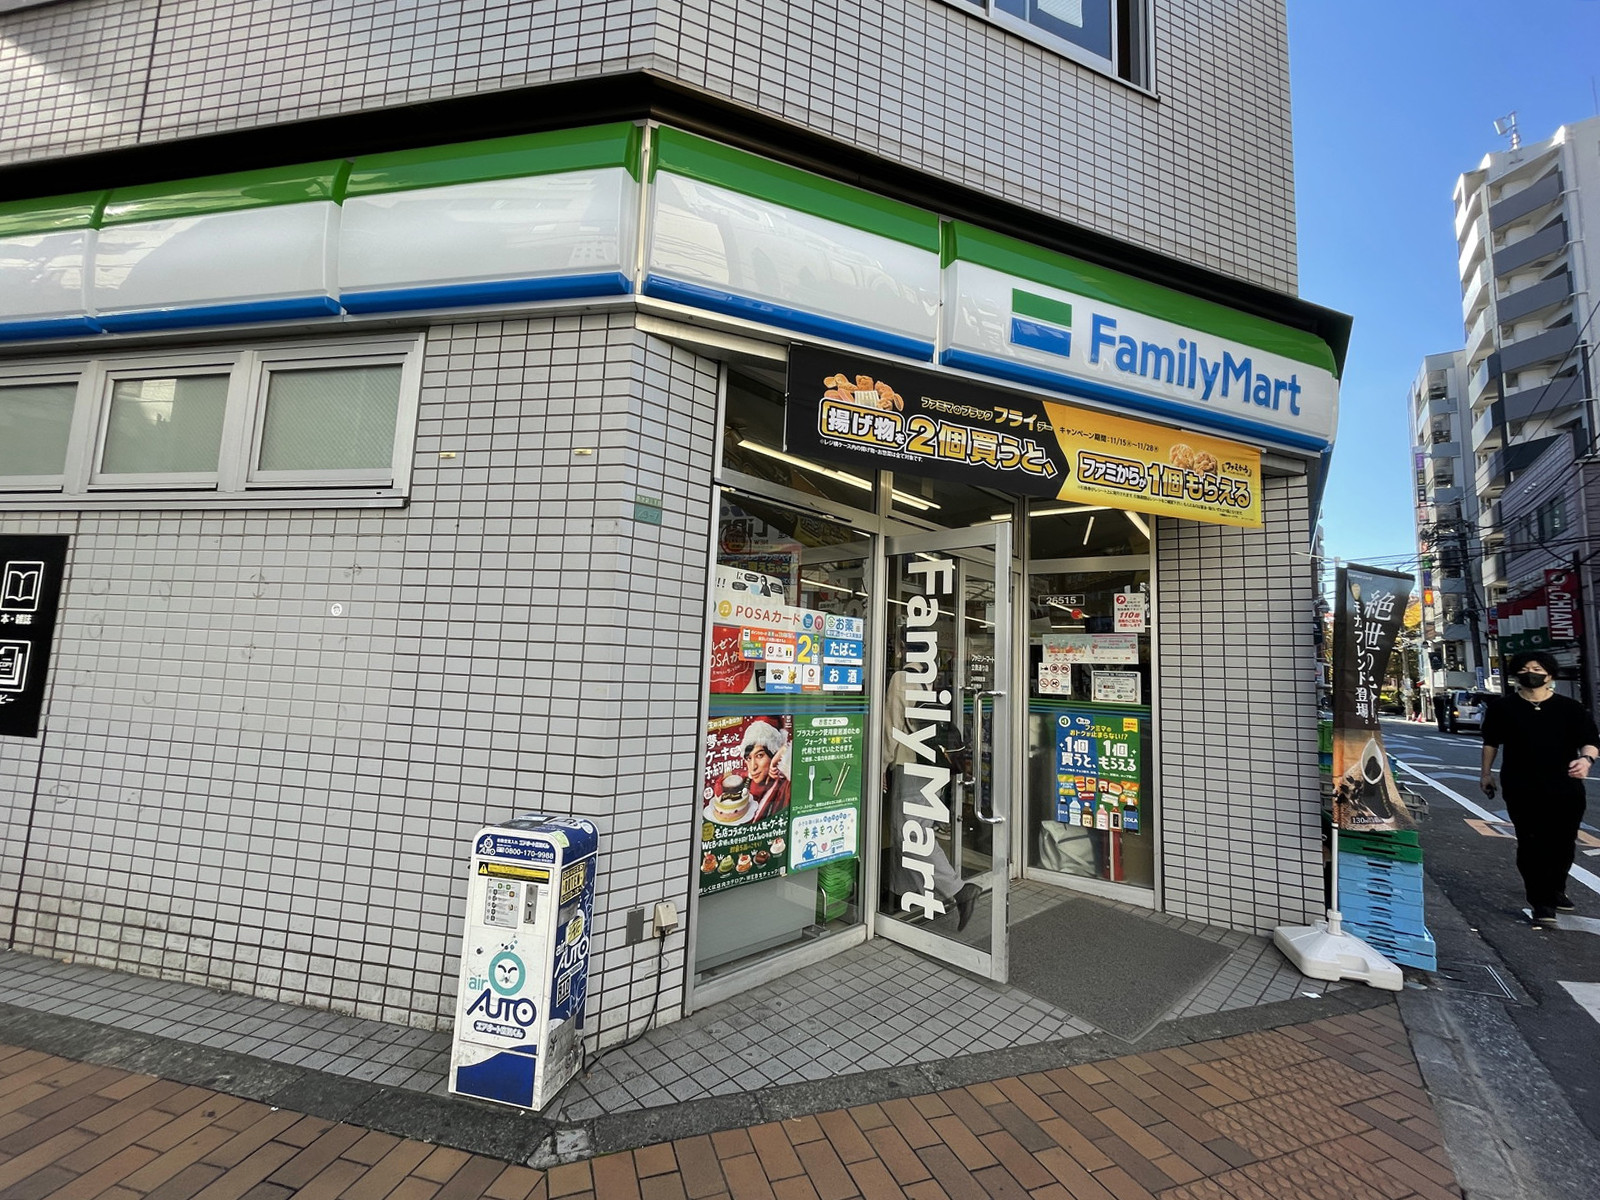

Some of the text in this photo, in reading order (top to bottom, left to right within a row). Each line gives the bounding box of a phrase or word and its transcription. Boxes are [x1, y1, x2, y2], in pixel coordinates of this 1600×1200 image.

[1091, 312, 1301, 416] FamilyMart
[828, 407, 1057, 478] 揚げ物を2個買うと、
[1046, 596, 1077, 604] 26515
[1, 613, 32, 625] 本・雑誌
[735, 605, 801, 625] POSAカード
[1549, 592, 1574, 640] CHIANTI
[797, 635, 812, 663] 2
[830, 642, 857, 657] たばこ
[829, 668, 857, 683] お酒
[892, 559, 953, 920] FamilyMart
[1065, 737, 1089, 753] 1個
[1103, 740, 1128, 757] 1個
[1061, 751, 1097, 768] 買うと、
[1098, 756, 1137, 772] もらえる
[553, 936, 590, 979] AUTO
[468, 975, 489, 991] air
[466, 988, 537, 1028] AUTO
